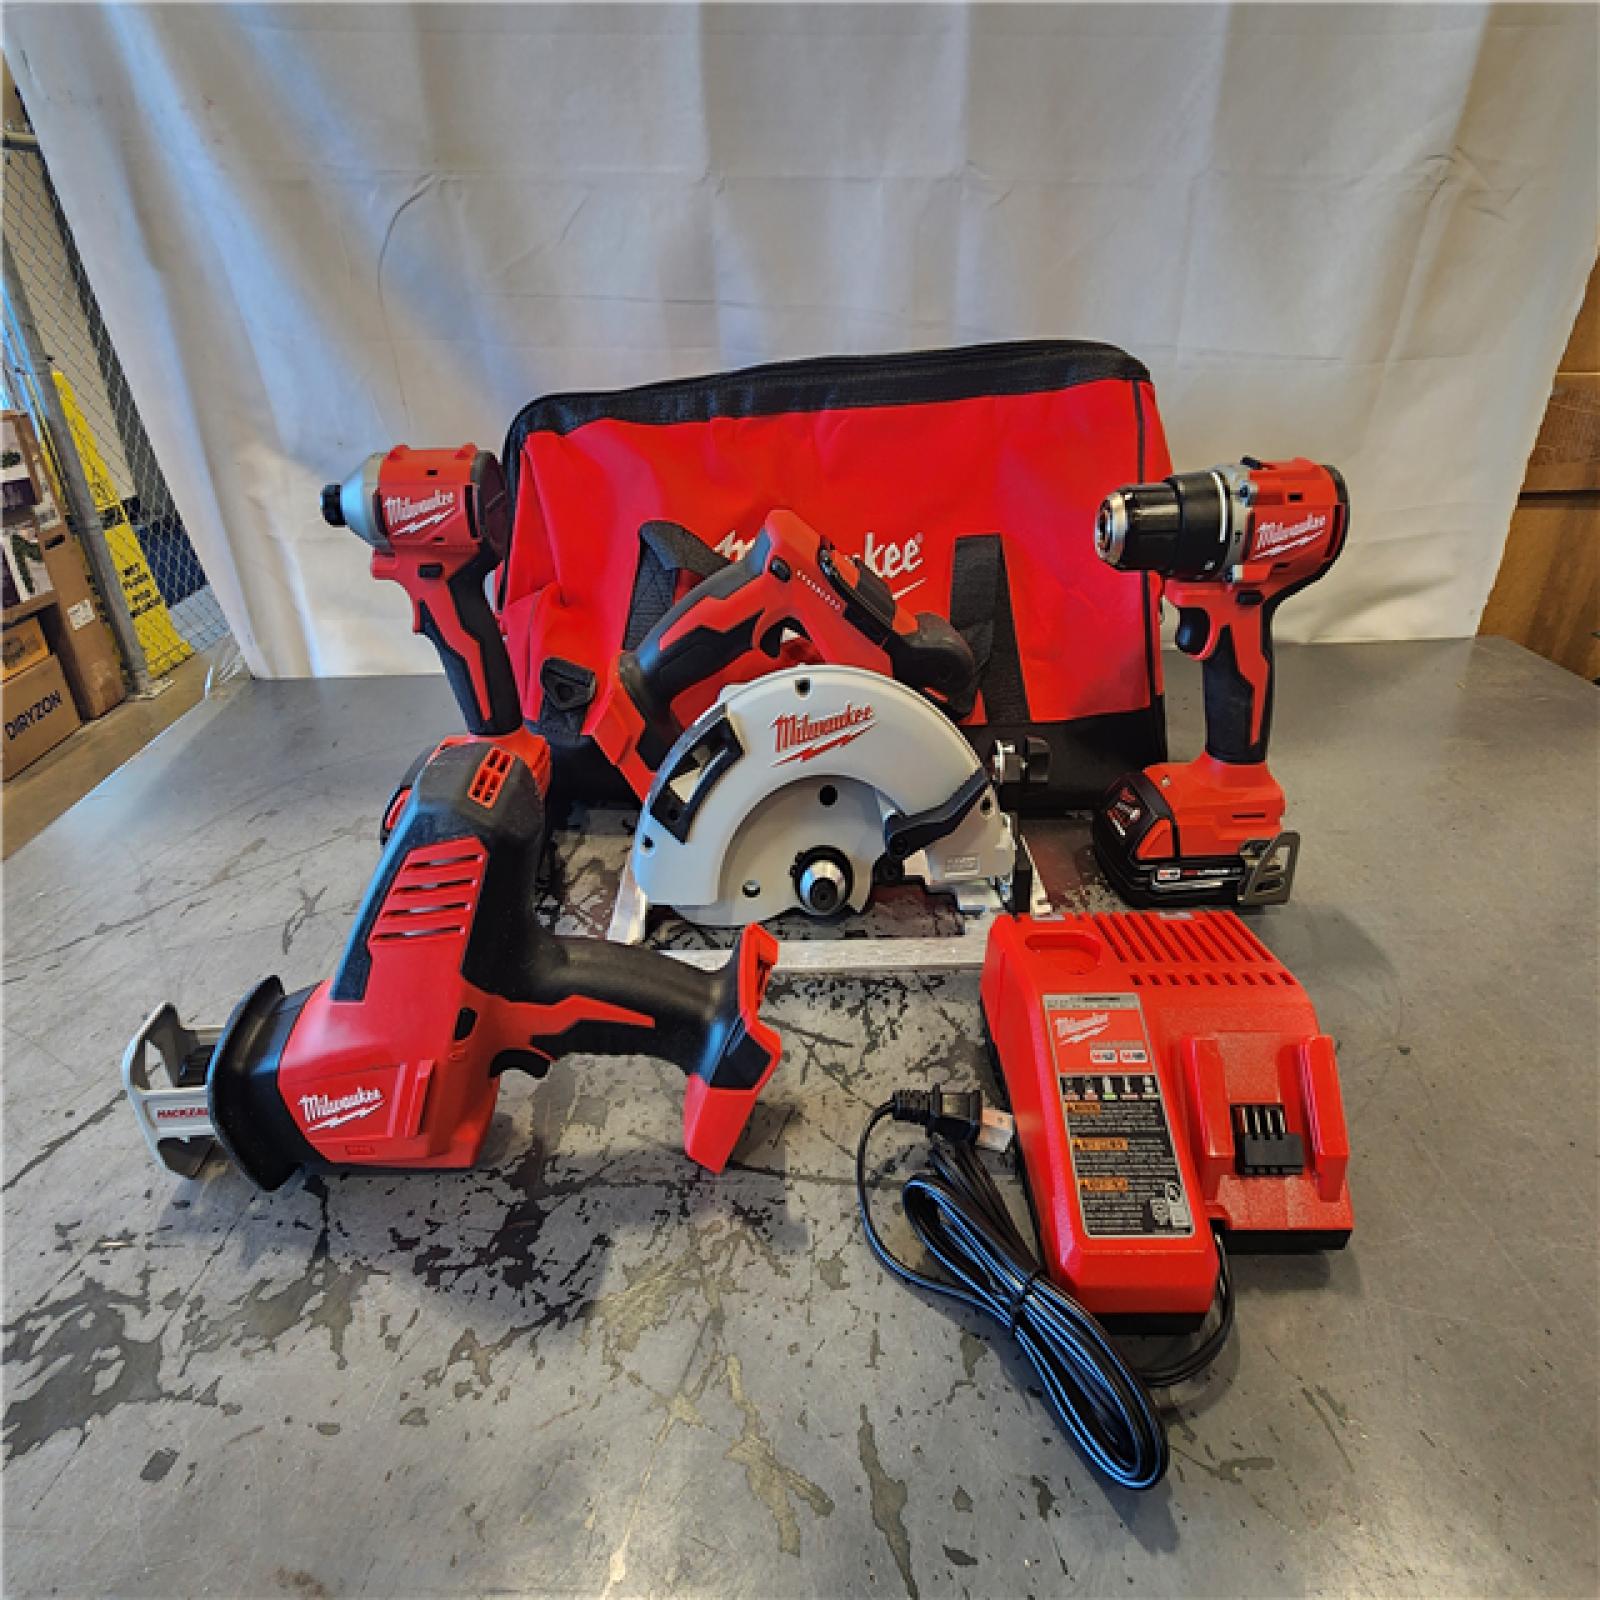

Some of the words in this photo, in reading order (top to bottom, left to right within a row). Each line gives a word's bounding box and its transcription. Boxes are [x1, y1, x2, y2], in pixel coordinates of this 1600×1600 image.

[384, 489, 454, 526] Milwaukee
[1257, 513, 1326, 551] Milwaukee
[769, 701, 874, 753] Milwaukee
[298, 1087, 382, 1123] Milwaukee
